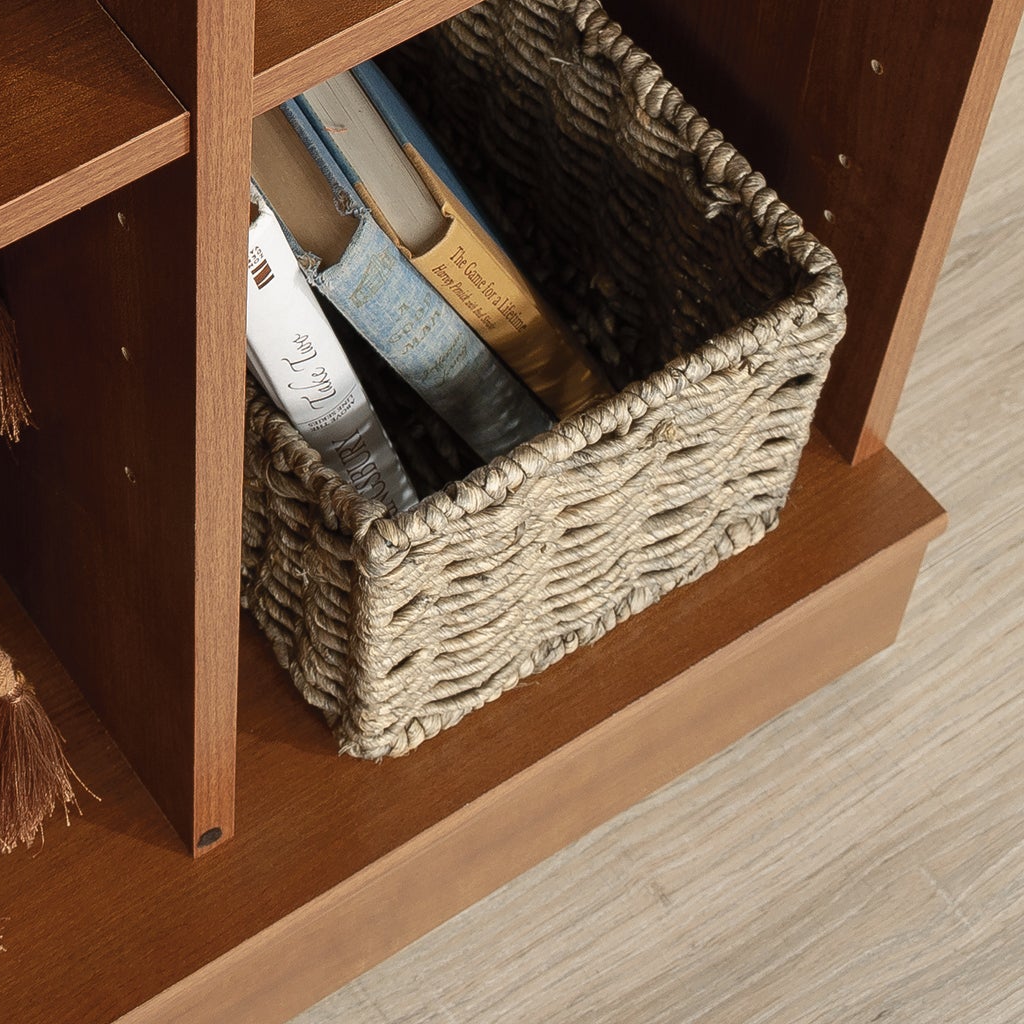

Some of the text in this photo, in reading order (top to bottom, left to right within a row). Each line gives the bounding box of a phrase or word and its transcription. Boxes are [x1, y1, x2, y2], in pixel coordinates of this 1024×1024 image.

[431, 263, 455, 287] Harvey
[449, 245, 527, 333] The Game for a Lifetime
[280, 333, 337, 410] Take Two
